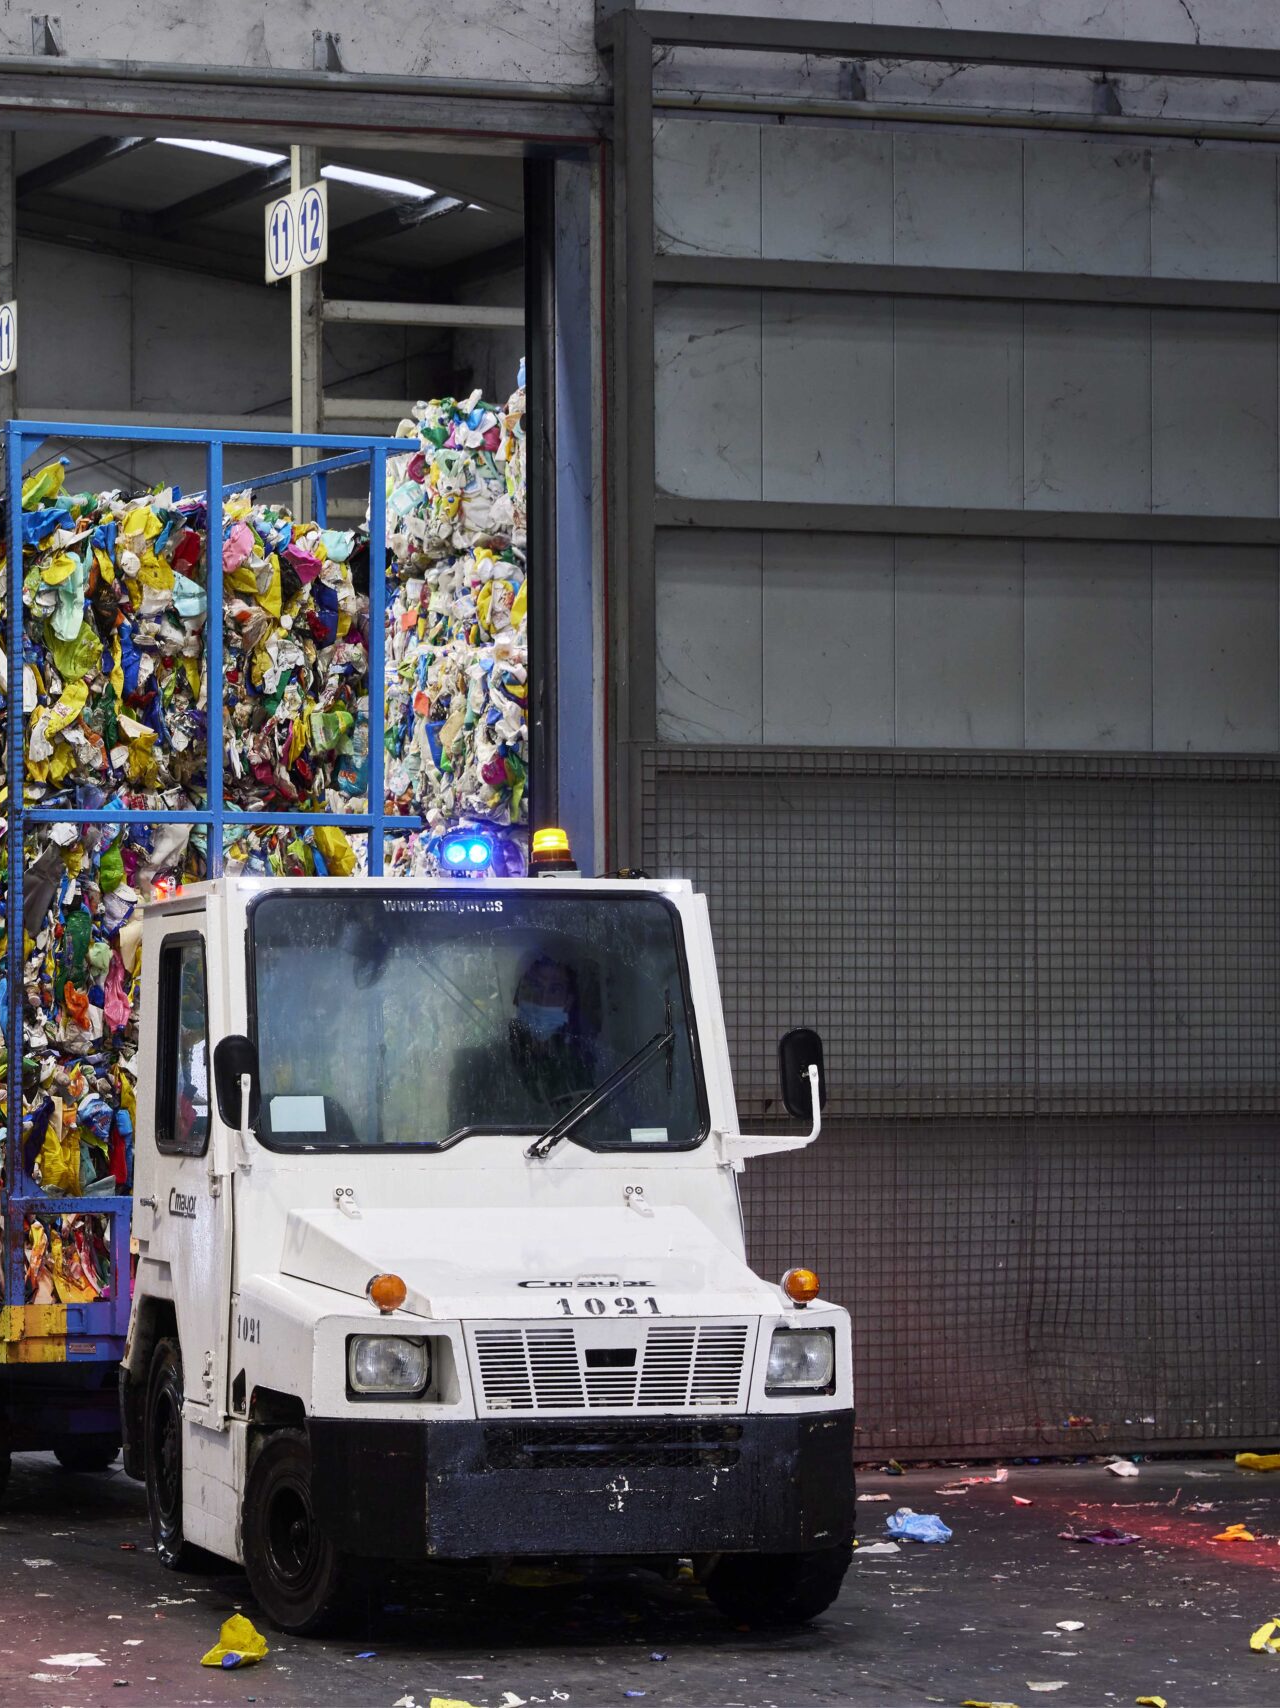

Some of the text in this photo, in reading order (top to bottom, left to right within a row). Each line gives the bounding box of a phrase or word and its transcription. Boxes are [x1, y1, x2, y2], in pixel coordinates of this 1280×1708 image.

[272, 198, 320, 265] 11 12
[168, 1187, 197, 1220] Cmayor
[556, 1297, 662, 1316] 1021
[237, 1314, 261, 1345] 1021
